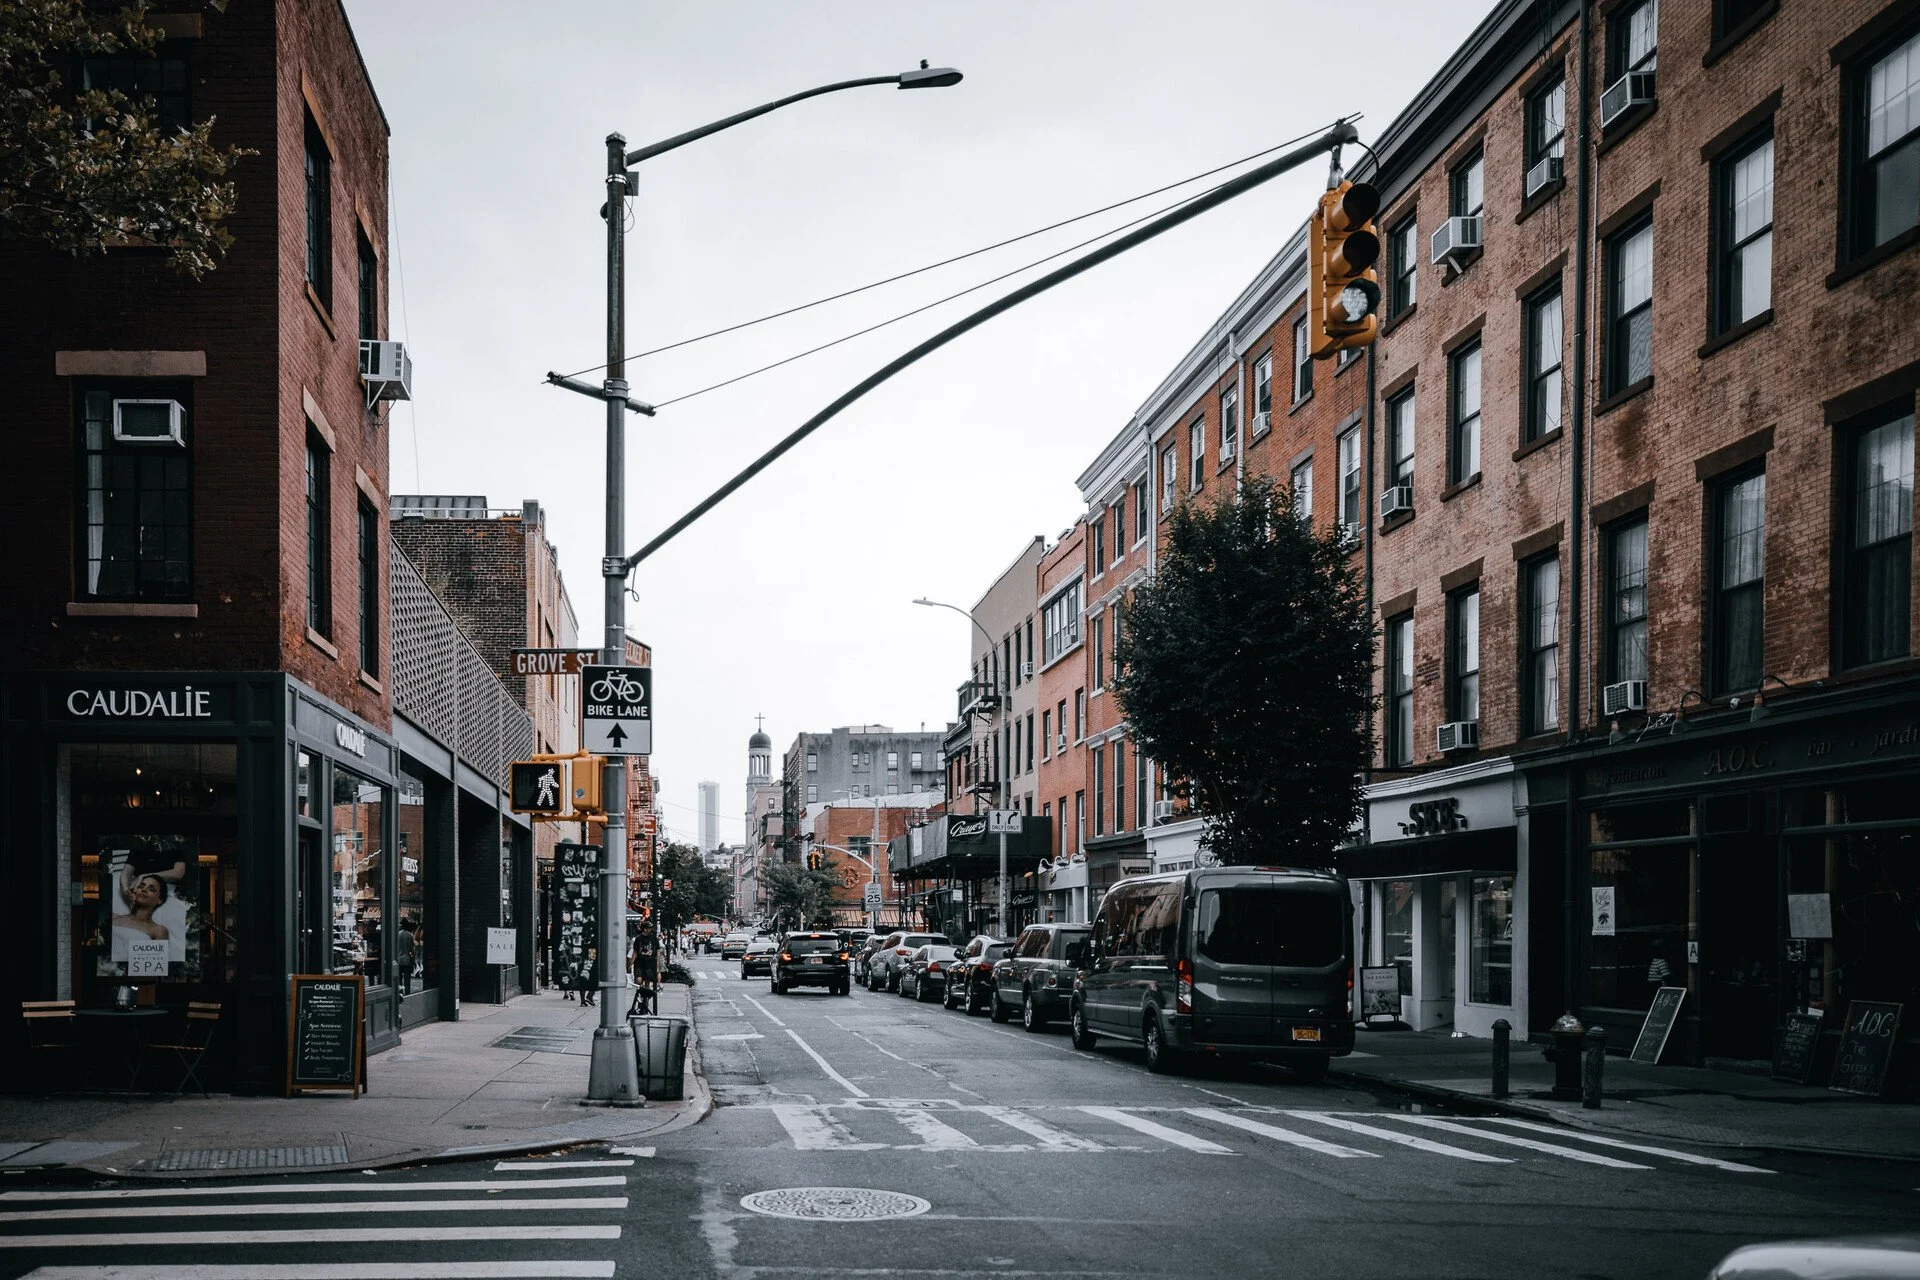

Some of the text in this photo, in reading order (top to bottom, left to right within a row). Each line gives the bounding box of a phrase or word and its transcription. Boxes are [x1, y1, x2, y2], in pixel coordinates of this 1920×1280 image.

[516, 652, 594, 674] GROVE ST
[587, 704, 648, 717] BIKE LANE
[867, 895, 881, 903] 25
[1690, 943, 1698, 957] A
[133, 961, 164, 973] SPA
